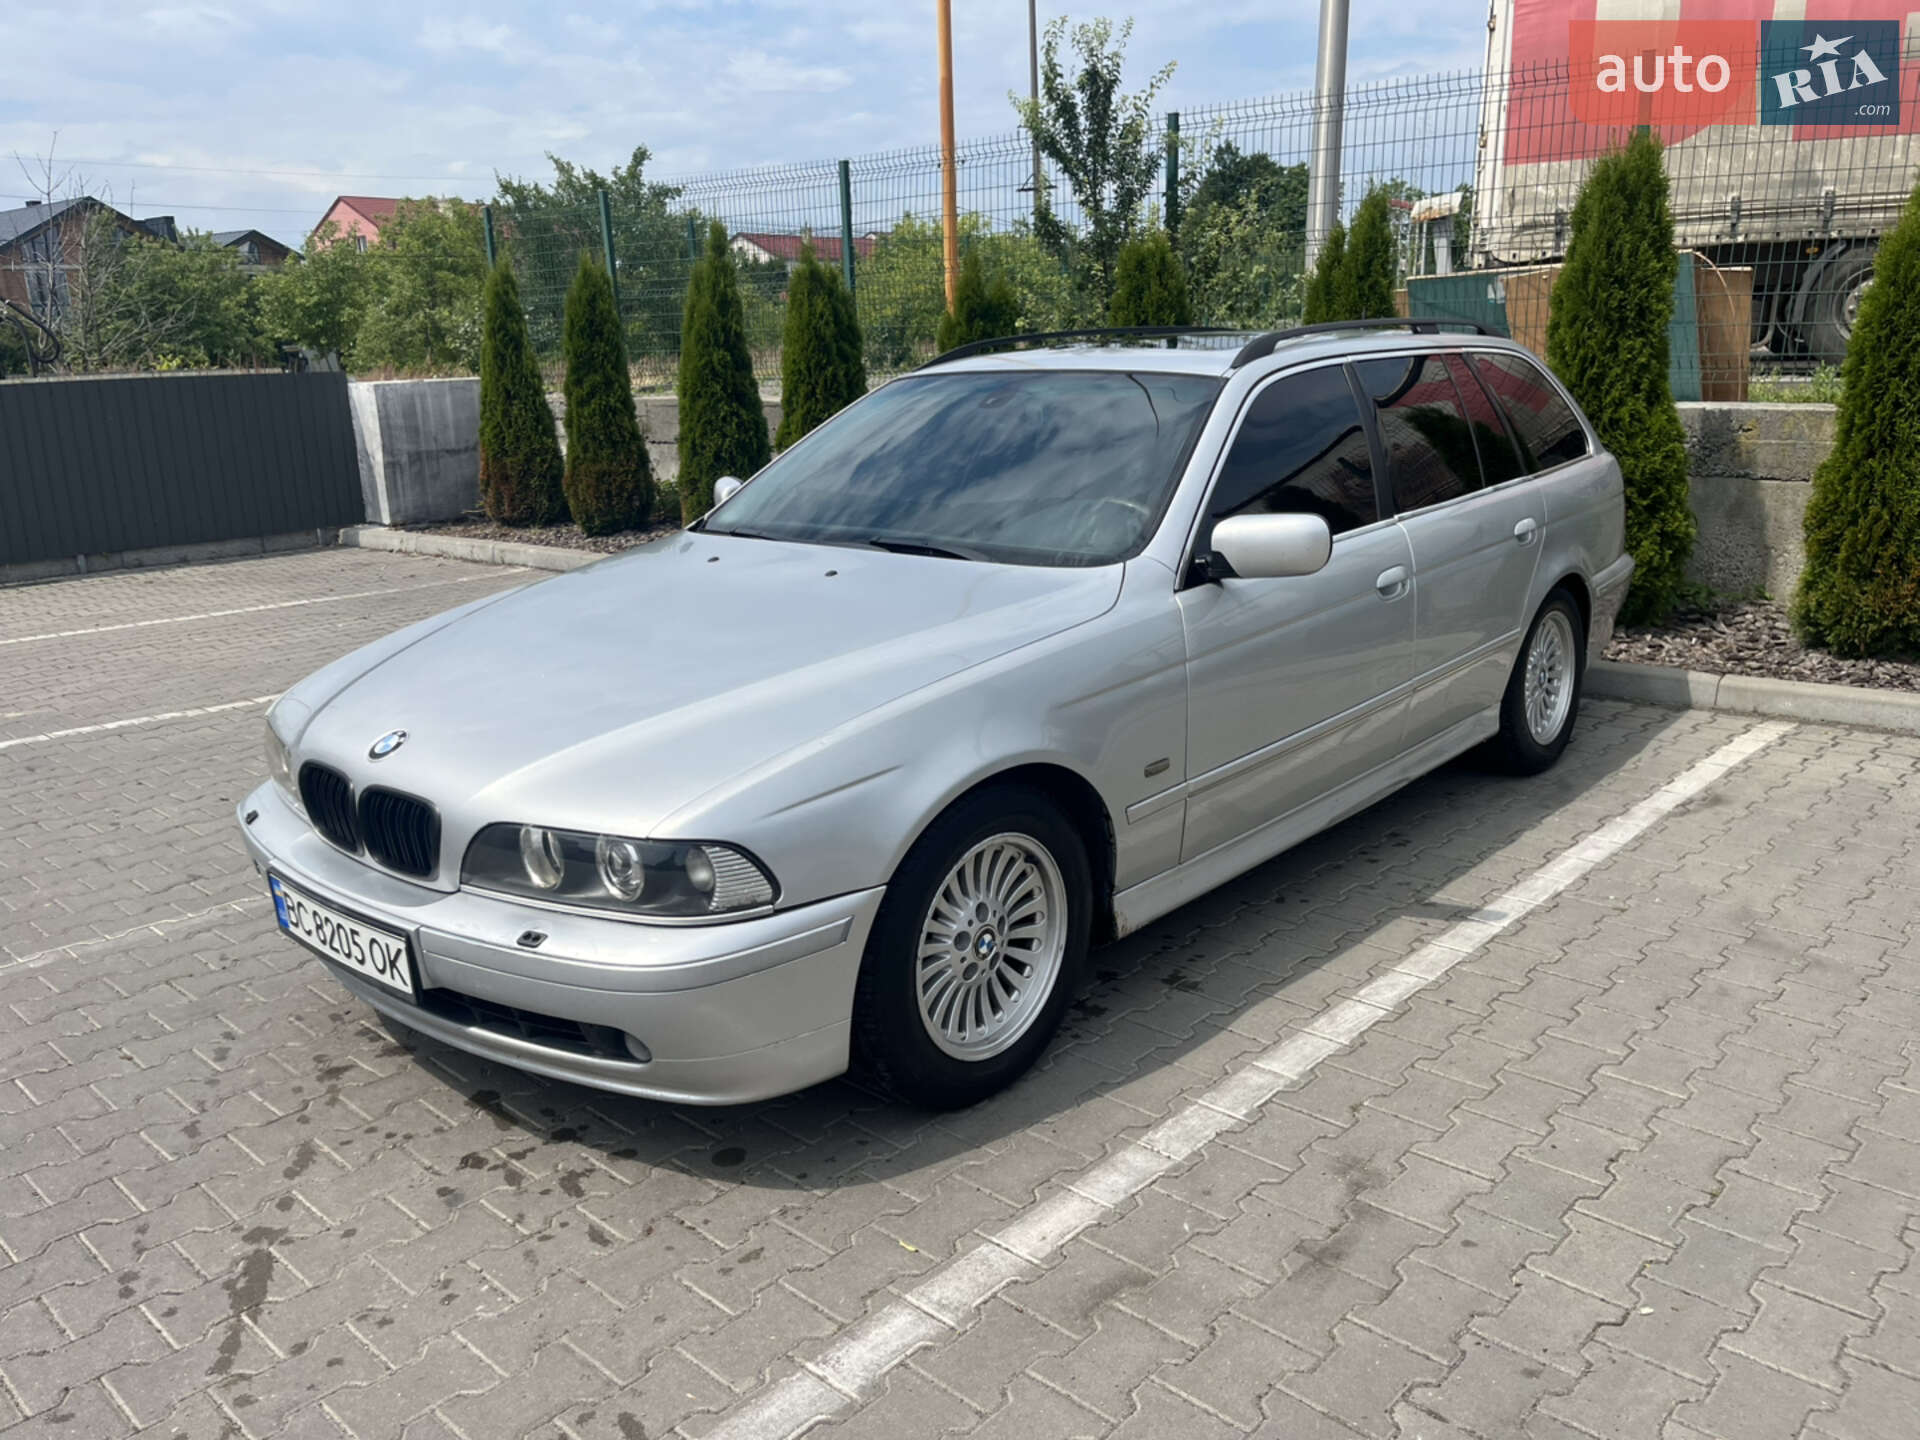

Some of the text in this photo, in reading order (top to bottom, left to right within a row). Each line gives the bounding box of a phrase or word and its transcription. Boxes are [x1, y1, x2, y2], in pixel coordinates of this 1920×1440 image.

[283, 891, 408, 987] BC 8205 OK
